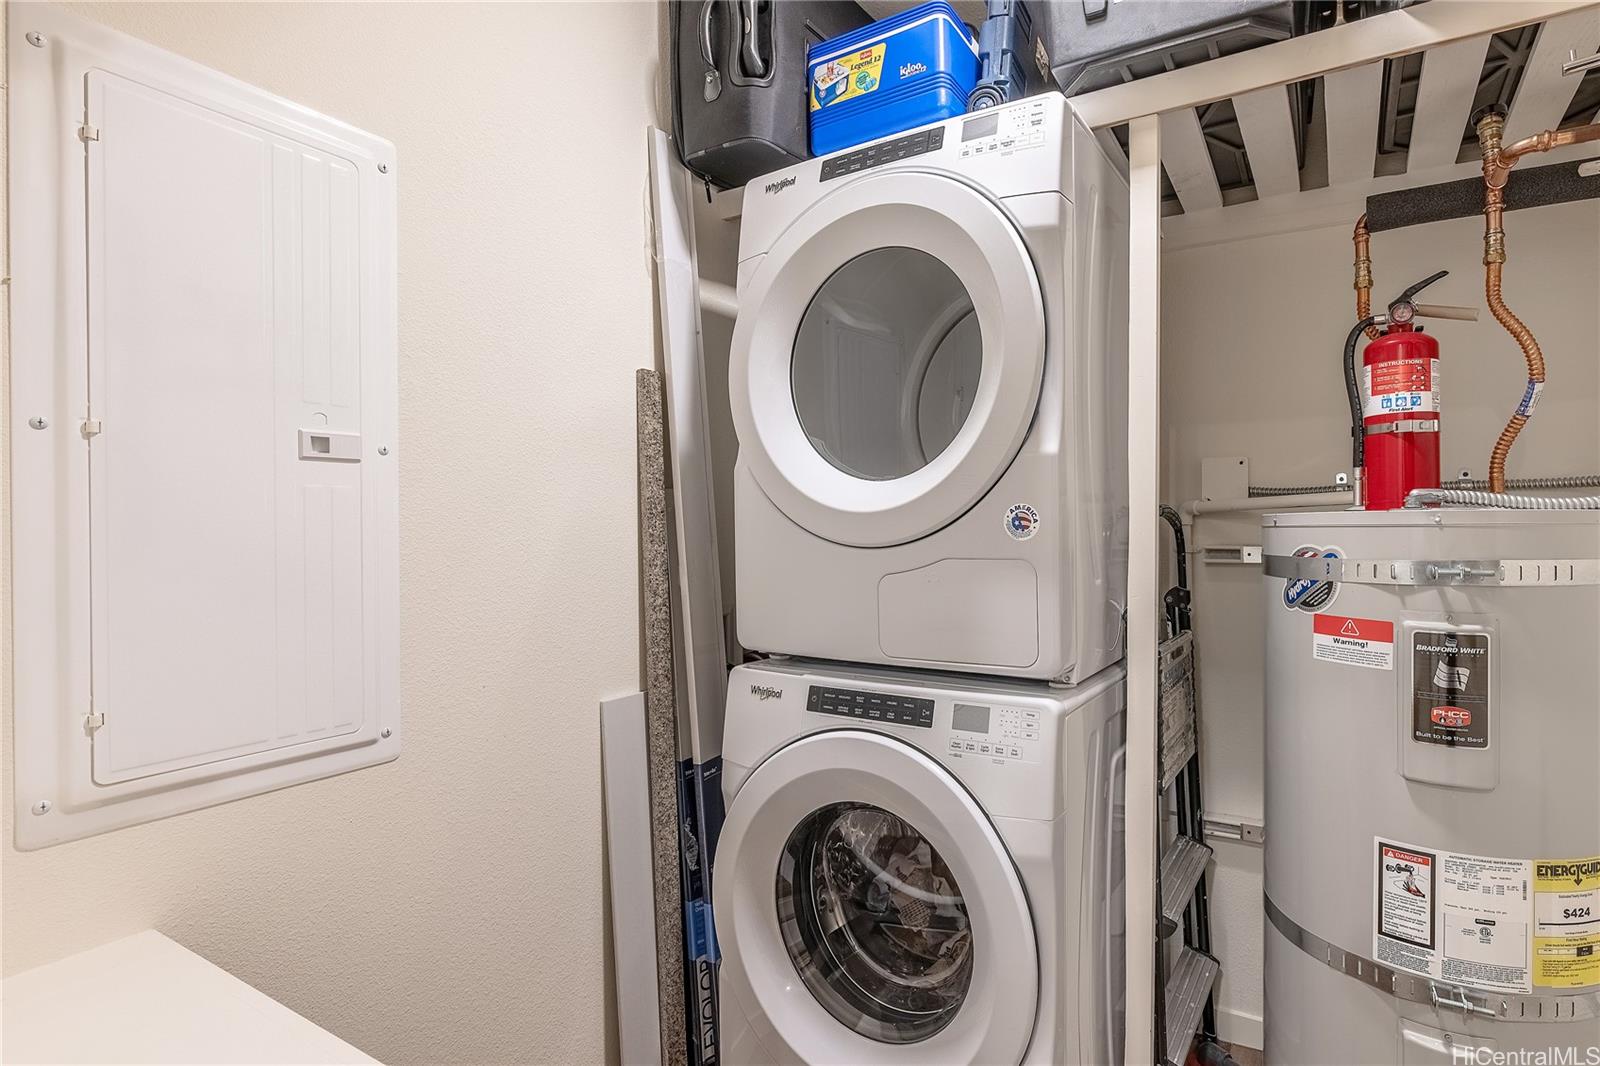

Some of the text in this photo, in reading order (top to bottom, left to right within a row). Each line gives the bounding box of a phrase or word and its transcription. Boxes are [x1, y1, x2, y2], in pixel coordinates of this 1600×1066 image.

[850, 55, 881, 71] Legend 12
[900, 63, 921, 77] igloo
[765, 176, 797, 195] Whirlpool
[1379, 359, 1423, 368] INSTRUCTIONS
[1009, 504, 1039, 525] AMERICA
[1333, 637, 1368, 648] Warning!
[1416, 644, 1459, 653] BRADFORD
[751, 685, 783, 701] Whirlpool
[1433, 709, 1469, 719] PHCC
[1416, 730, 1431, 738] Built
[1442, 733, 1452, 741] be
[1467, 735, 1484, 743] Best
[1395, 852, 1424, 864] DANGER
[1537, 861, 1600, 878] ENERGYGUID
[1563, 906, 1591, 919] $424
